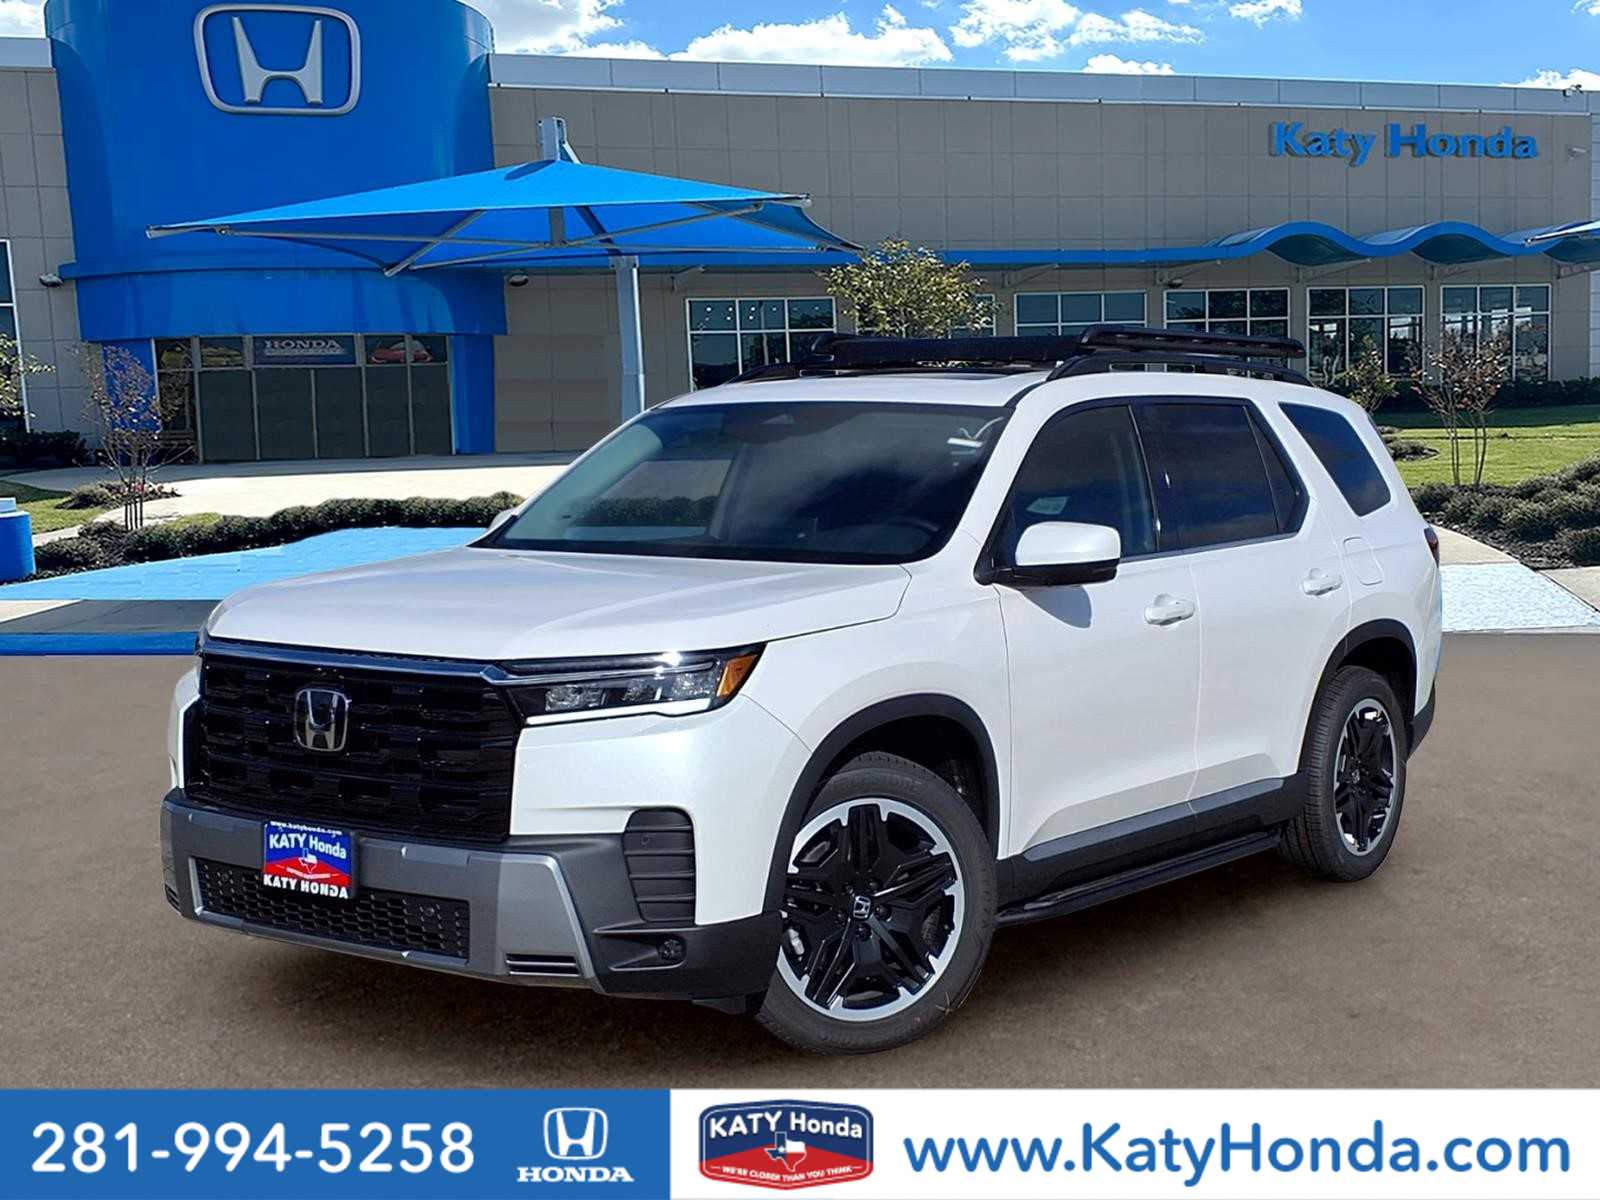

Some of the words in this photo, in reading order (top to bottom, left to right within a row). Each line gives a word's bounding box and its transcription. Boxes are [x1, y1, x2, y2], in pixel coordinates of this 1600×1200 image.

[1270, 120, 1376, 168] Katy
[1385, 121, 1539, 160] Honda
[264, 339, 342, 349] HONDA
[269, 833, 307, 849] KATY
[309, 835, 347, 859] Honda
[263, 873, 298, 890] KATY
[300, 879, 349, 899] HONDA
